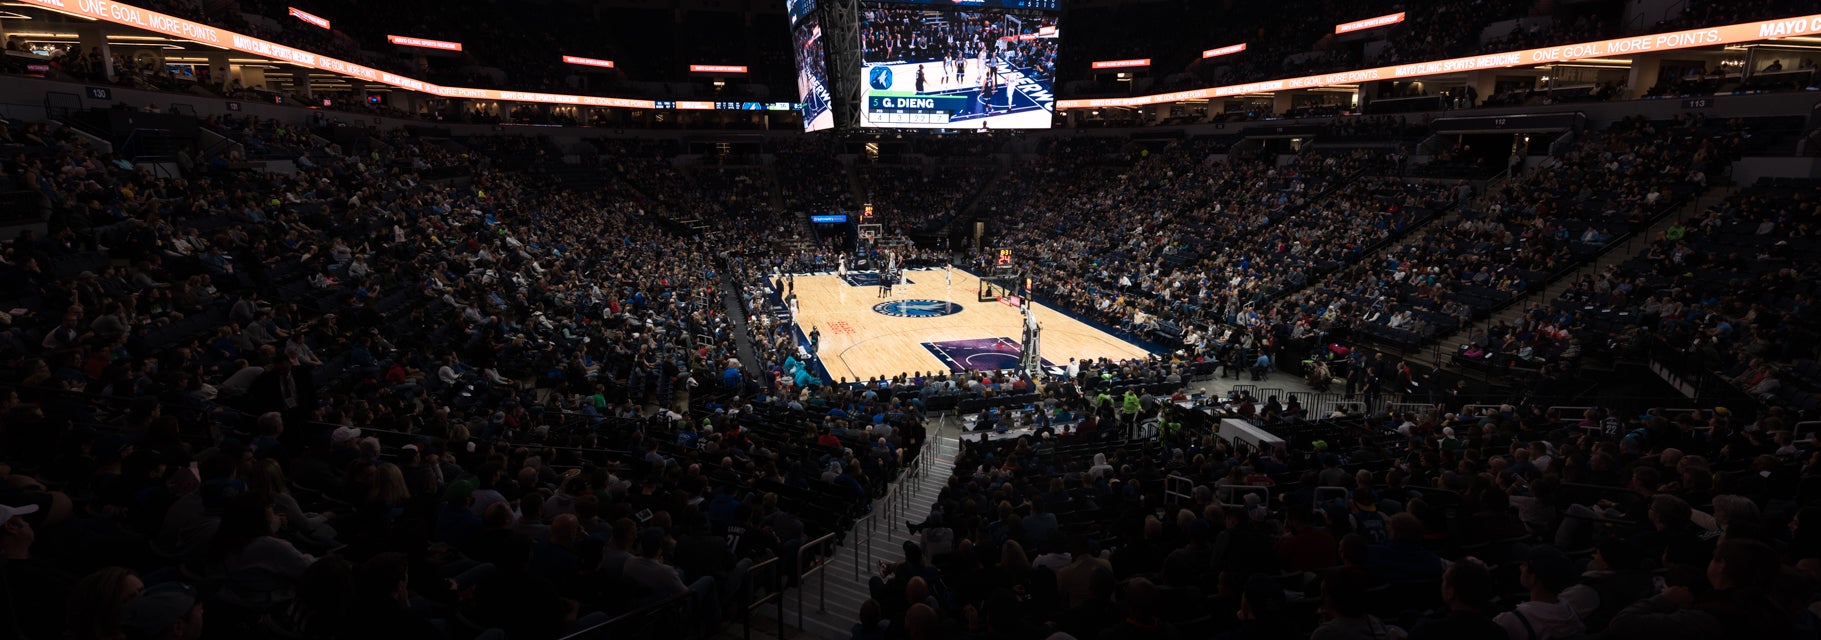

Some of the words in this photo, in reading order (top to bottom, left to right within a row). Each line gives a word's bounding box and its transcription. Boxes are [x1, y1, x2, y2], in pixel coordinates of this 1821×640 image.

[79, 0, 108, 17] ONE
[111, 4, 147, 27] GOAL.
[149, 13, 181, 34] MORE
[182, 22, 220, 43] POINTS.
[1759, 19, 1807, 38] MAYO
[232, 35, 252, 50] MAYO
[252, 40, 271, 54] CLINIC
[271, 45, 292, 59] SPORTS
[292, 50, 316, 65] MEDICINE
[1532, 48, 1560, 62] ONE
[1563, 44, 1603, 58] GOAL.
[1607, 37, 1652, 53] MORE
[1655, 29, 1722, 48] POINTS.
[1395, 66, 1416, 76] MAYO
[1416, 62, 1442, 74] CLINIC
[1443, 58, 1476, 71] SPORTS
[1477, 53, 1521, 67] MEDICINE
[1326, 74, 1347, 84] MORE
[93, 88, 106, 99] 130
[873, 98, 879, 107] 5
[882, 98, 895, 108] G.
[897, 98, 935, 109] DIENG
[1690, 99, 1705, 108] 113
[998, 255, 1011, 265] 24
